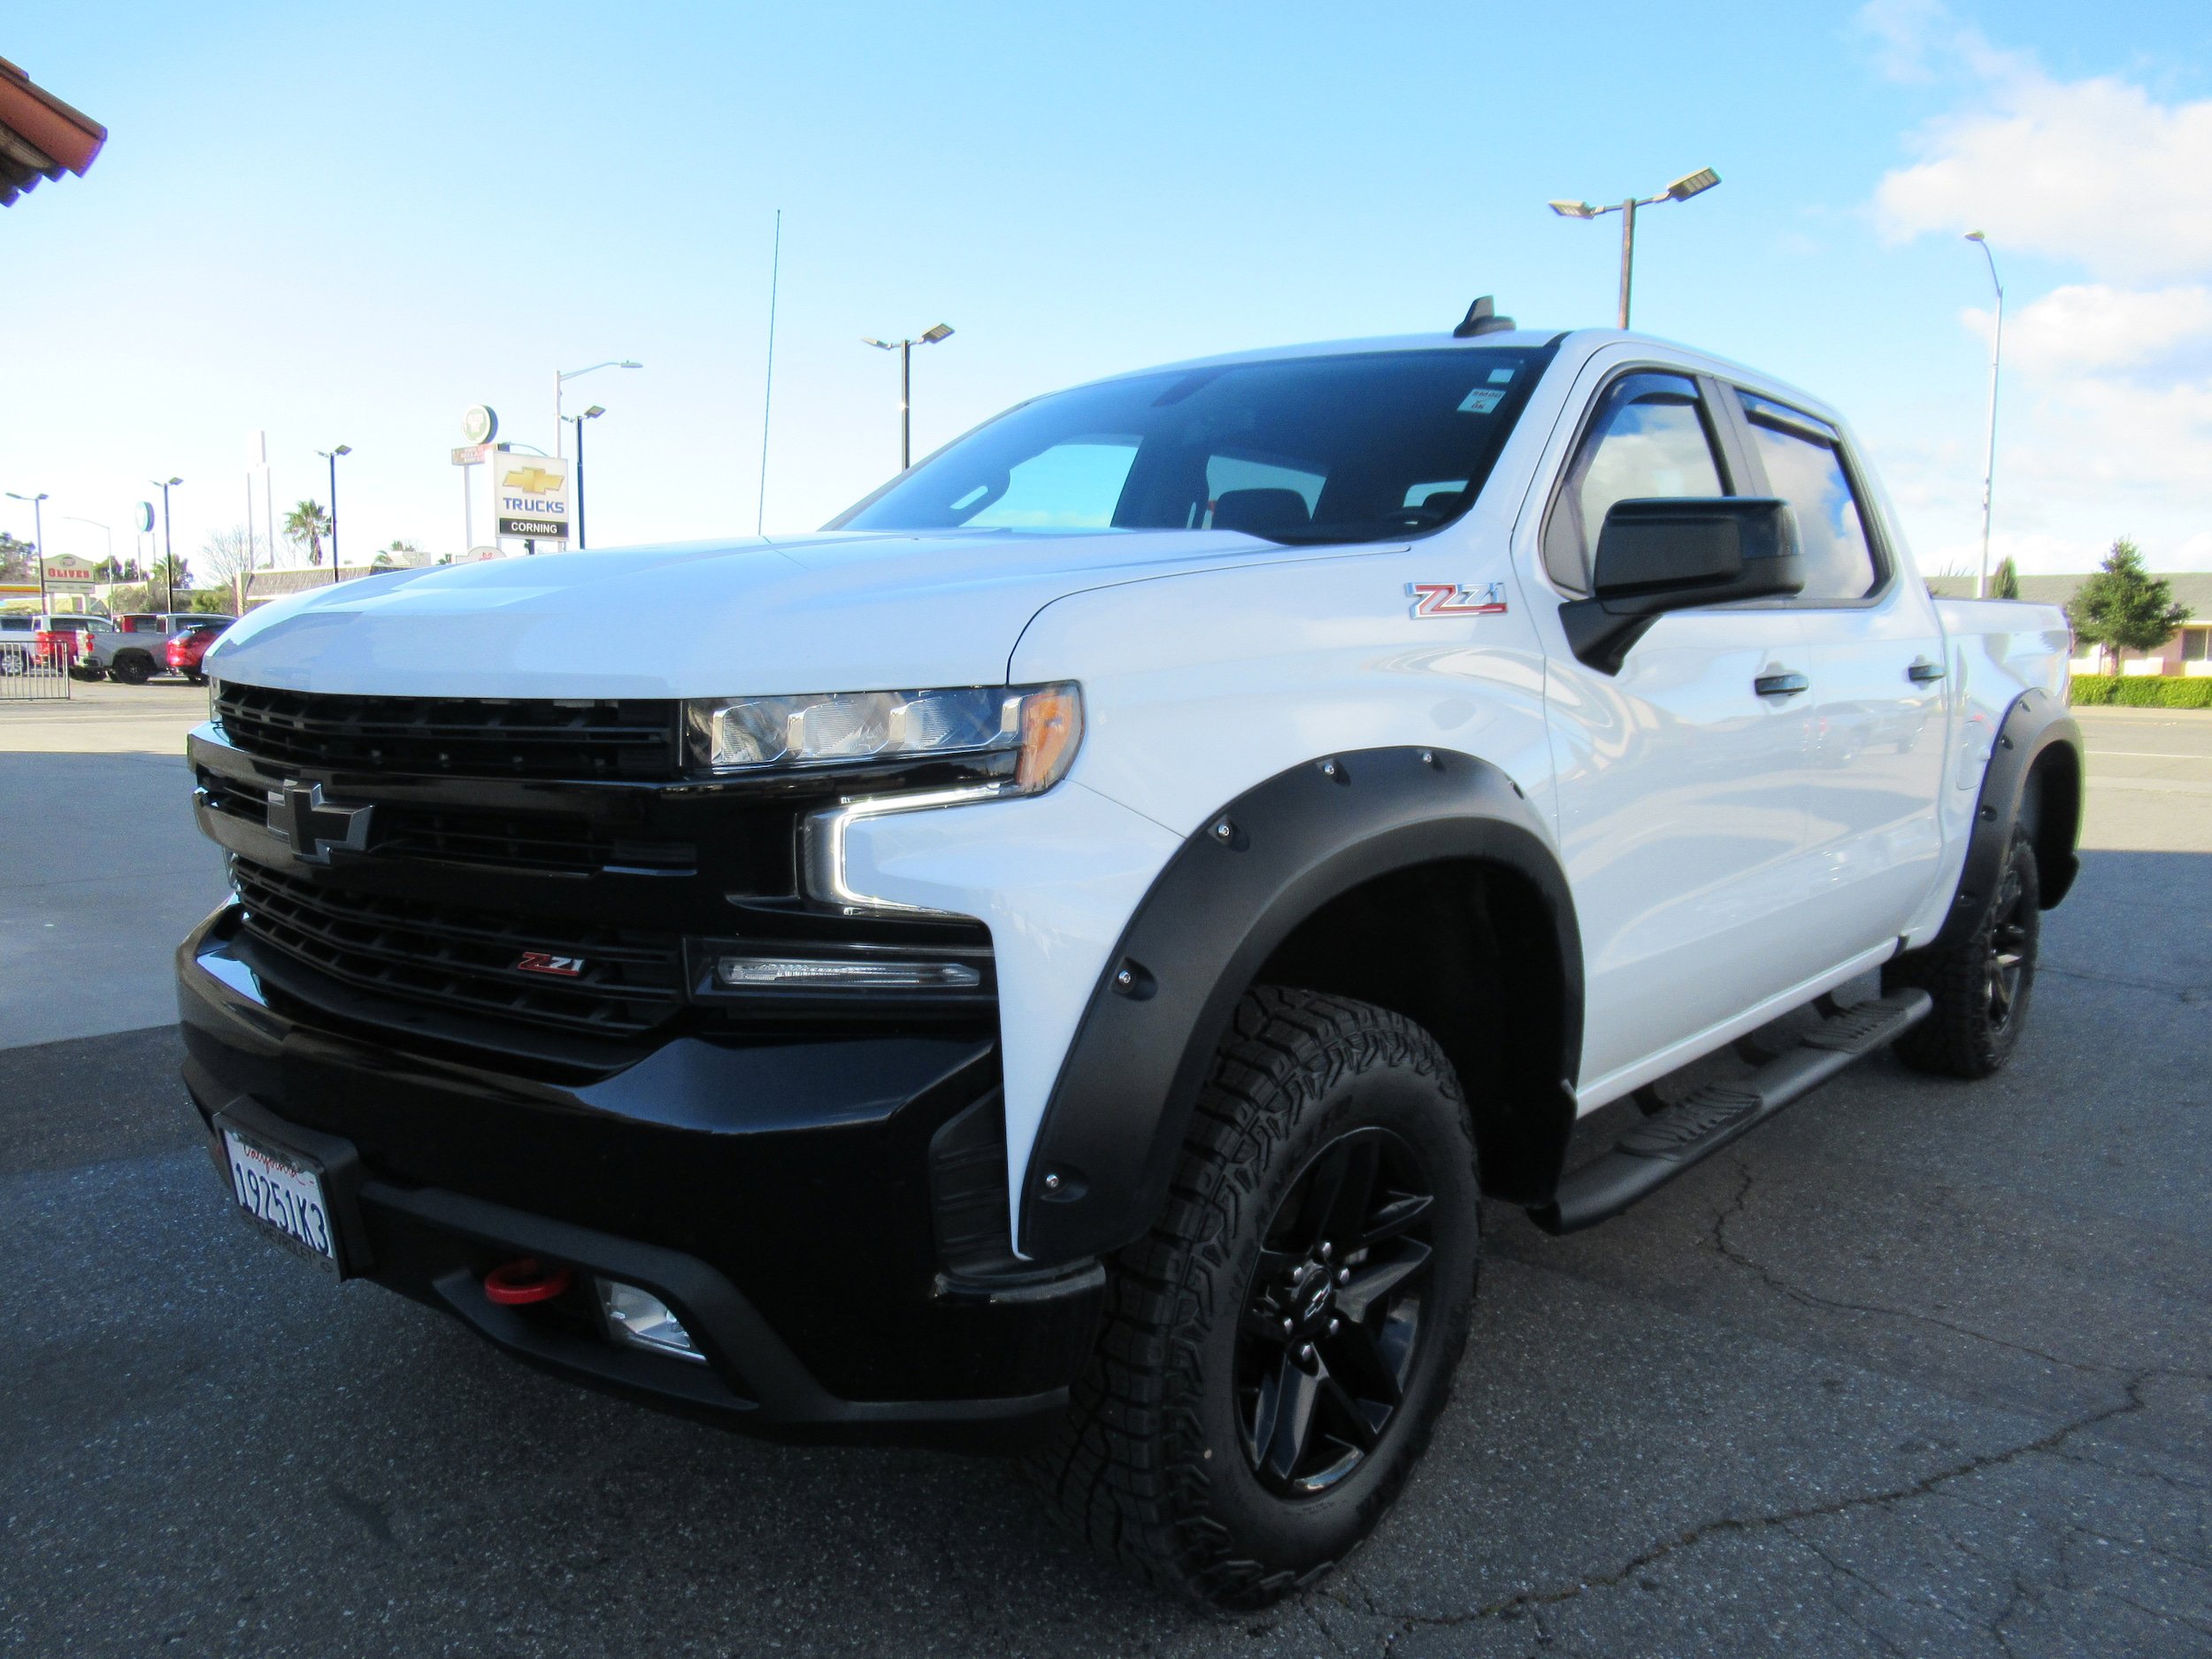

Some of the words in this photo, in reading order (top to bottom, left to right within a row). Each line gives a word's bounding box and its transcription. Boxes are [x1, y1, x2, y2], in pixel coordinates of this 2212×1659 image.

[503, 497, 565, 514] TRUCKS
[511, 521, 557, 534] CORNING
[1404, 582, 1508, 619] Z71
[518, 951, 584, 977] Z71
[235, 1163, 329, 1256] 19251K3
